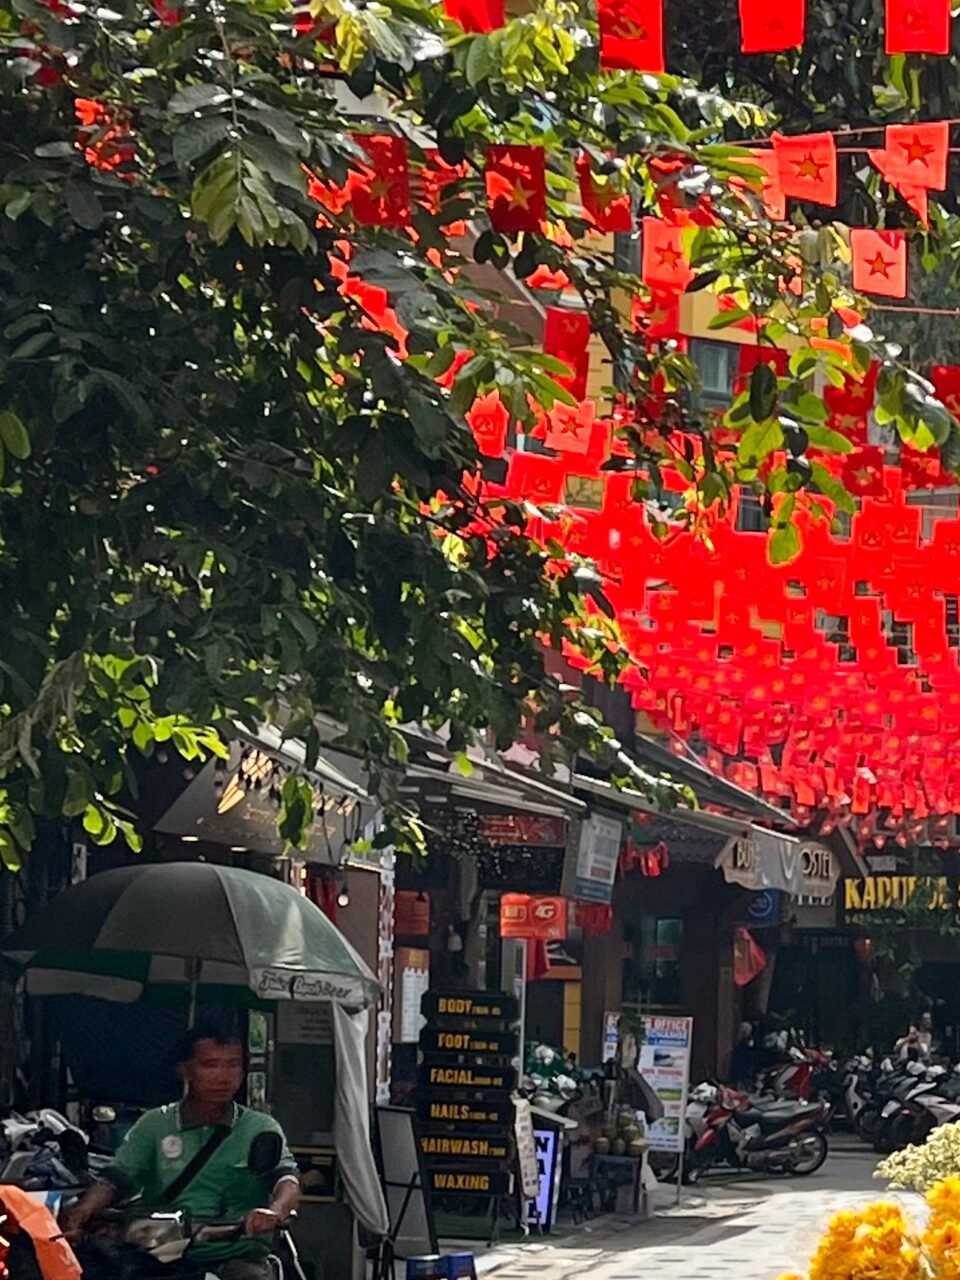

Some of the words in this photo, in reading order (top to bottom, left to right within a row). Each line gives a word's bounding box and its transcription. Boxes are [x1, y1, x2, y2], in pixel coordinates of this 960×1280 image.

[535, 904, 555, 919] 4G
[438, 998, 473, 1014] BODY
[438, 1033, 470, 1050] FOOT
[430, 1068, 474, 1085] FACIAL
[430, 1103, 470, 1120] NAILS
[434, 1174, 490, 1191] WAXING
